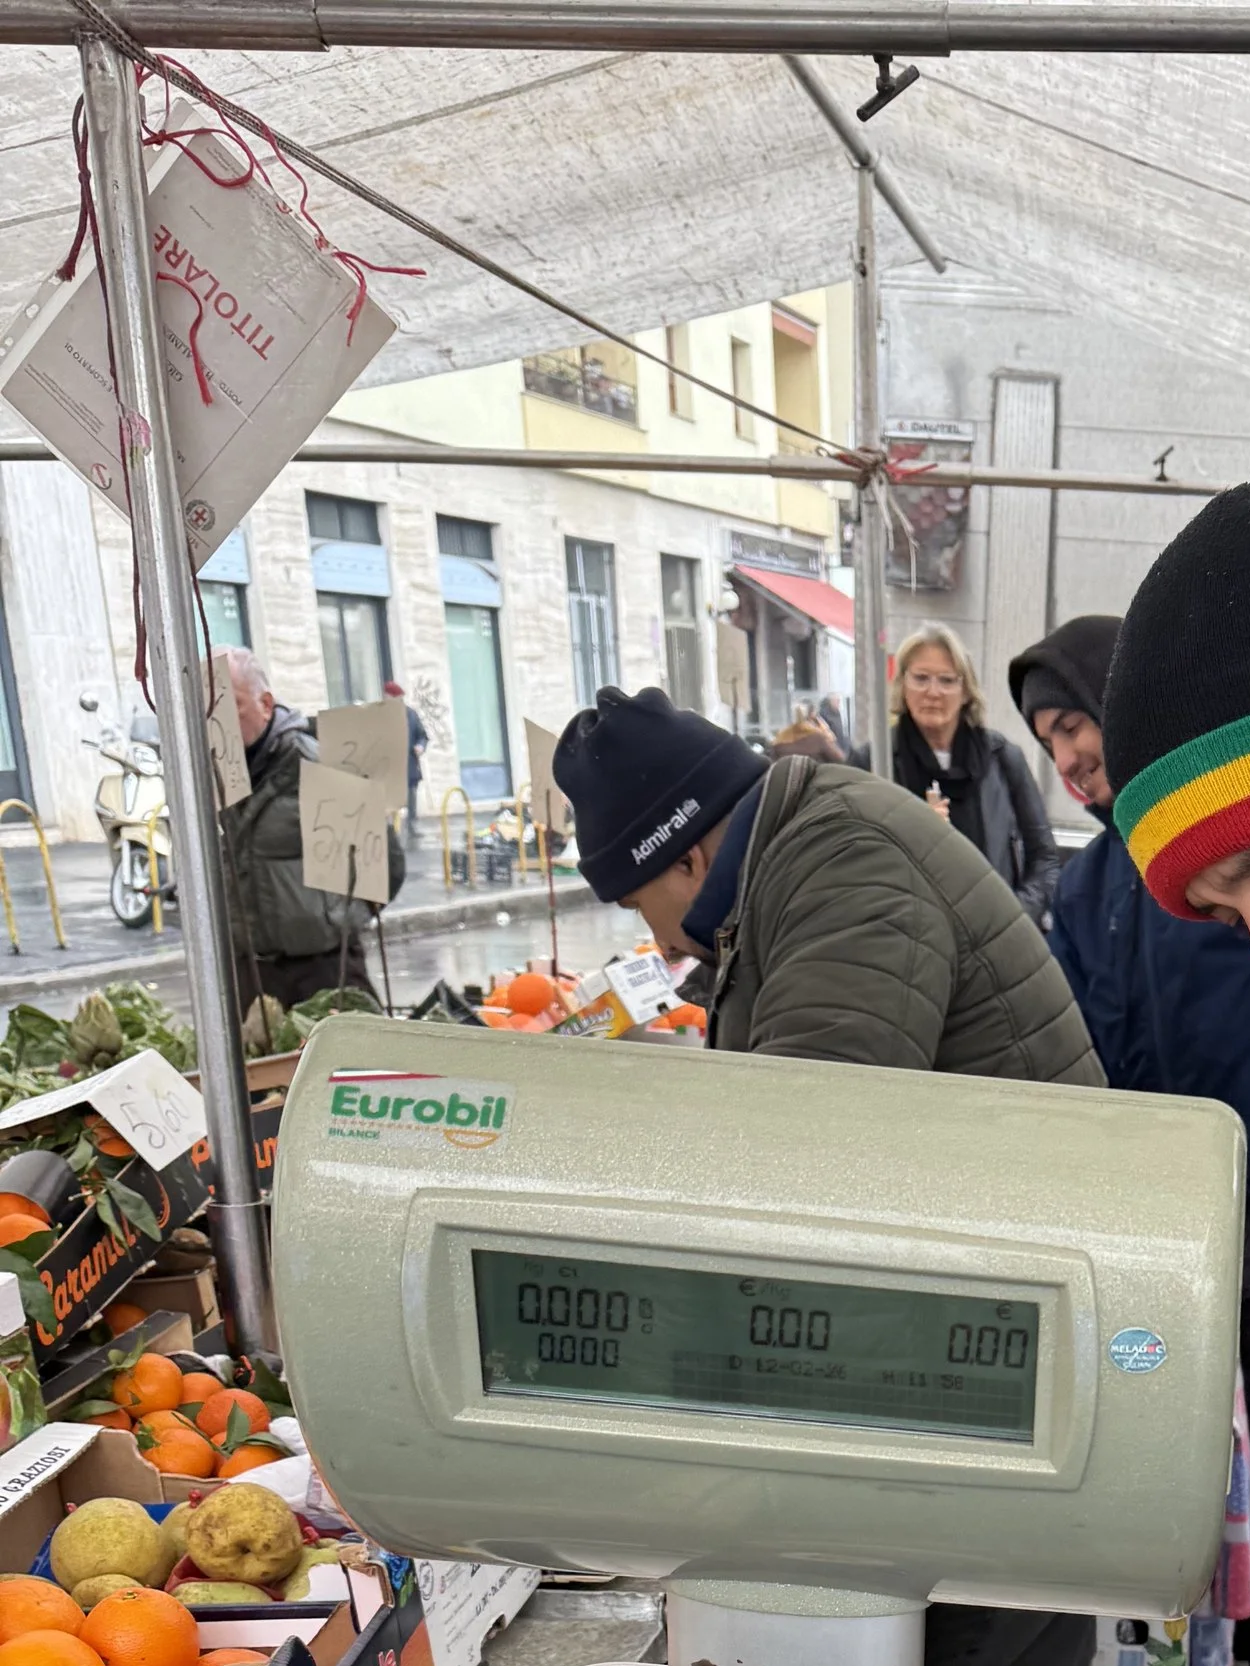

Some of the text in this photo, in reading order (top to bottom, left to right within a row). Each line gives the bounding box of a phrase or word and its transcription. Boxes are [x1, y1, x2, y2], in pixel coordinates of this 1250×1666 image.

[153, 223, 274, 361] TITOLARE
[631, 807, 688, 865] Admiral
[331, 1085, 506, 1129] Eurobil
[328, 1127, 380, 1140] BILANCE
[2, 1445, 71, 1489] GRAZIOSI
